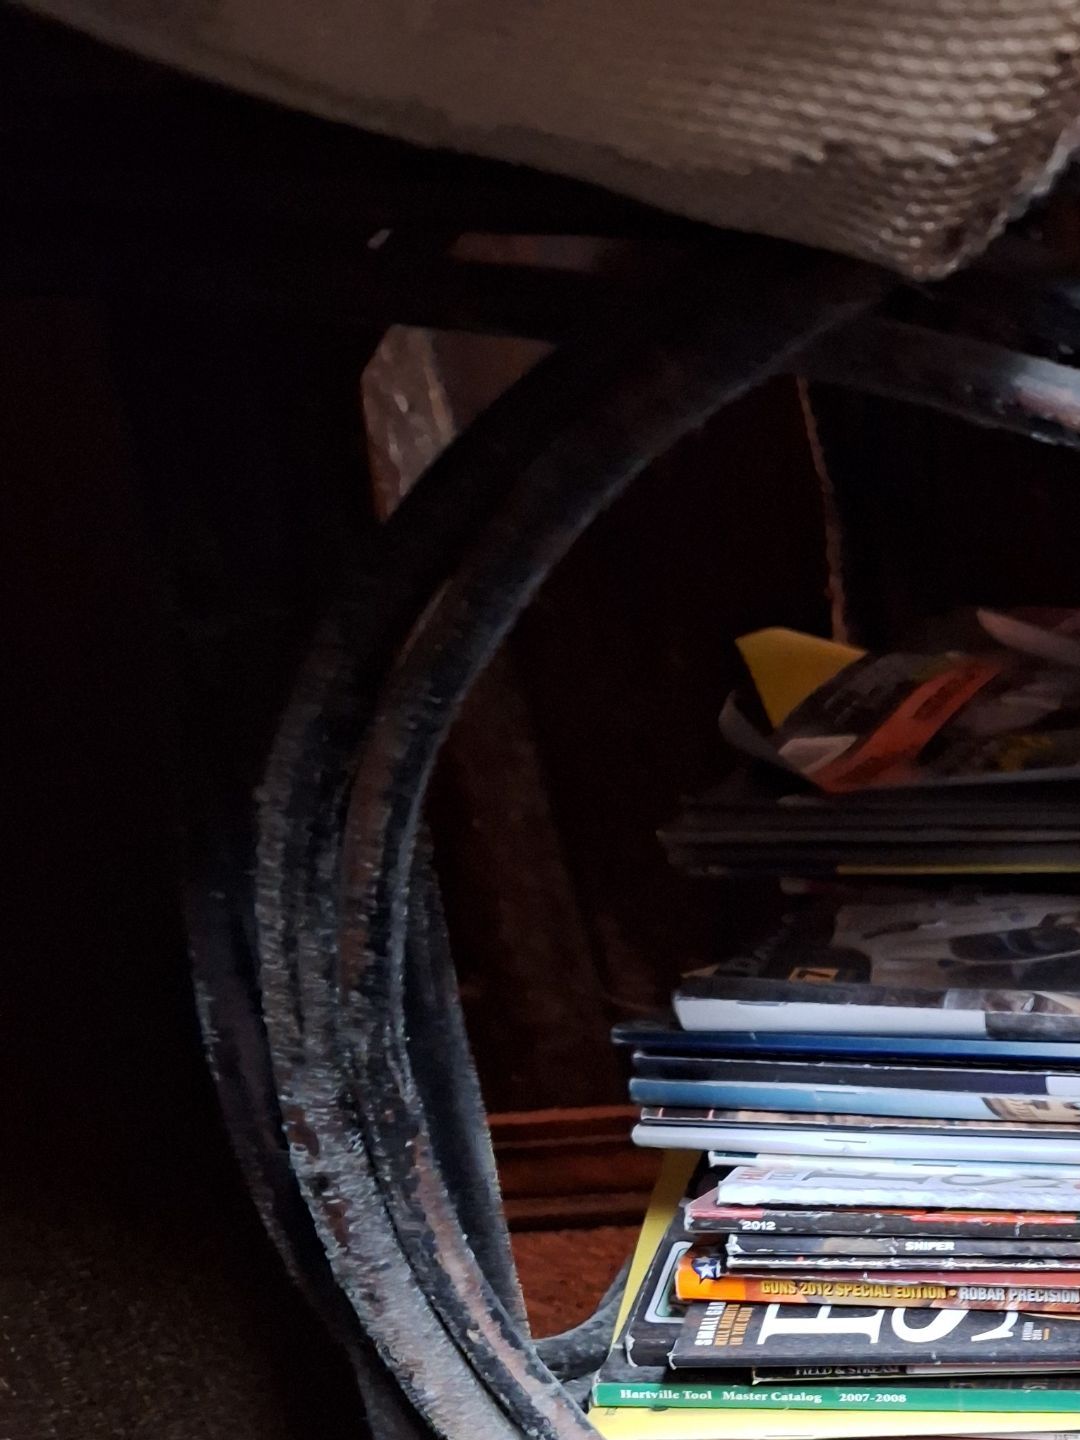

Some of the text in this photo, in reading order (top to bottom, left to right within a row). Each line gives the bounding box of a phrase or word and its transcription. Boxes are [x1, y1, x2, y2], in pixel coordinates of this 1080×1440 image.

[741, 1220, 776, 1231] 2012
[905, 1241, 955, 1251] SNIPER
[760, 1280, 798, 1295] GUNS
[799, 1282, 833, 1297] 2012
[835, 1283, 892, 1298] SPECIAL
[894, 1285, 946, 1300] EDITION
[959, 1287, 1006, 1302] ROBAR
[1008, 1288, 1080, 1303] PRECISION
[694, 1316, 720, 1346] SMALL
[620, 1388, 907, 1404] Hartville Tool Master Catalog 2007-2008
